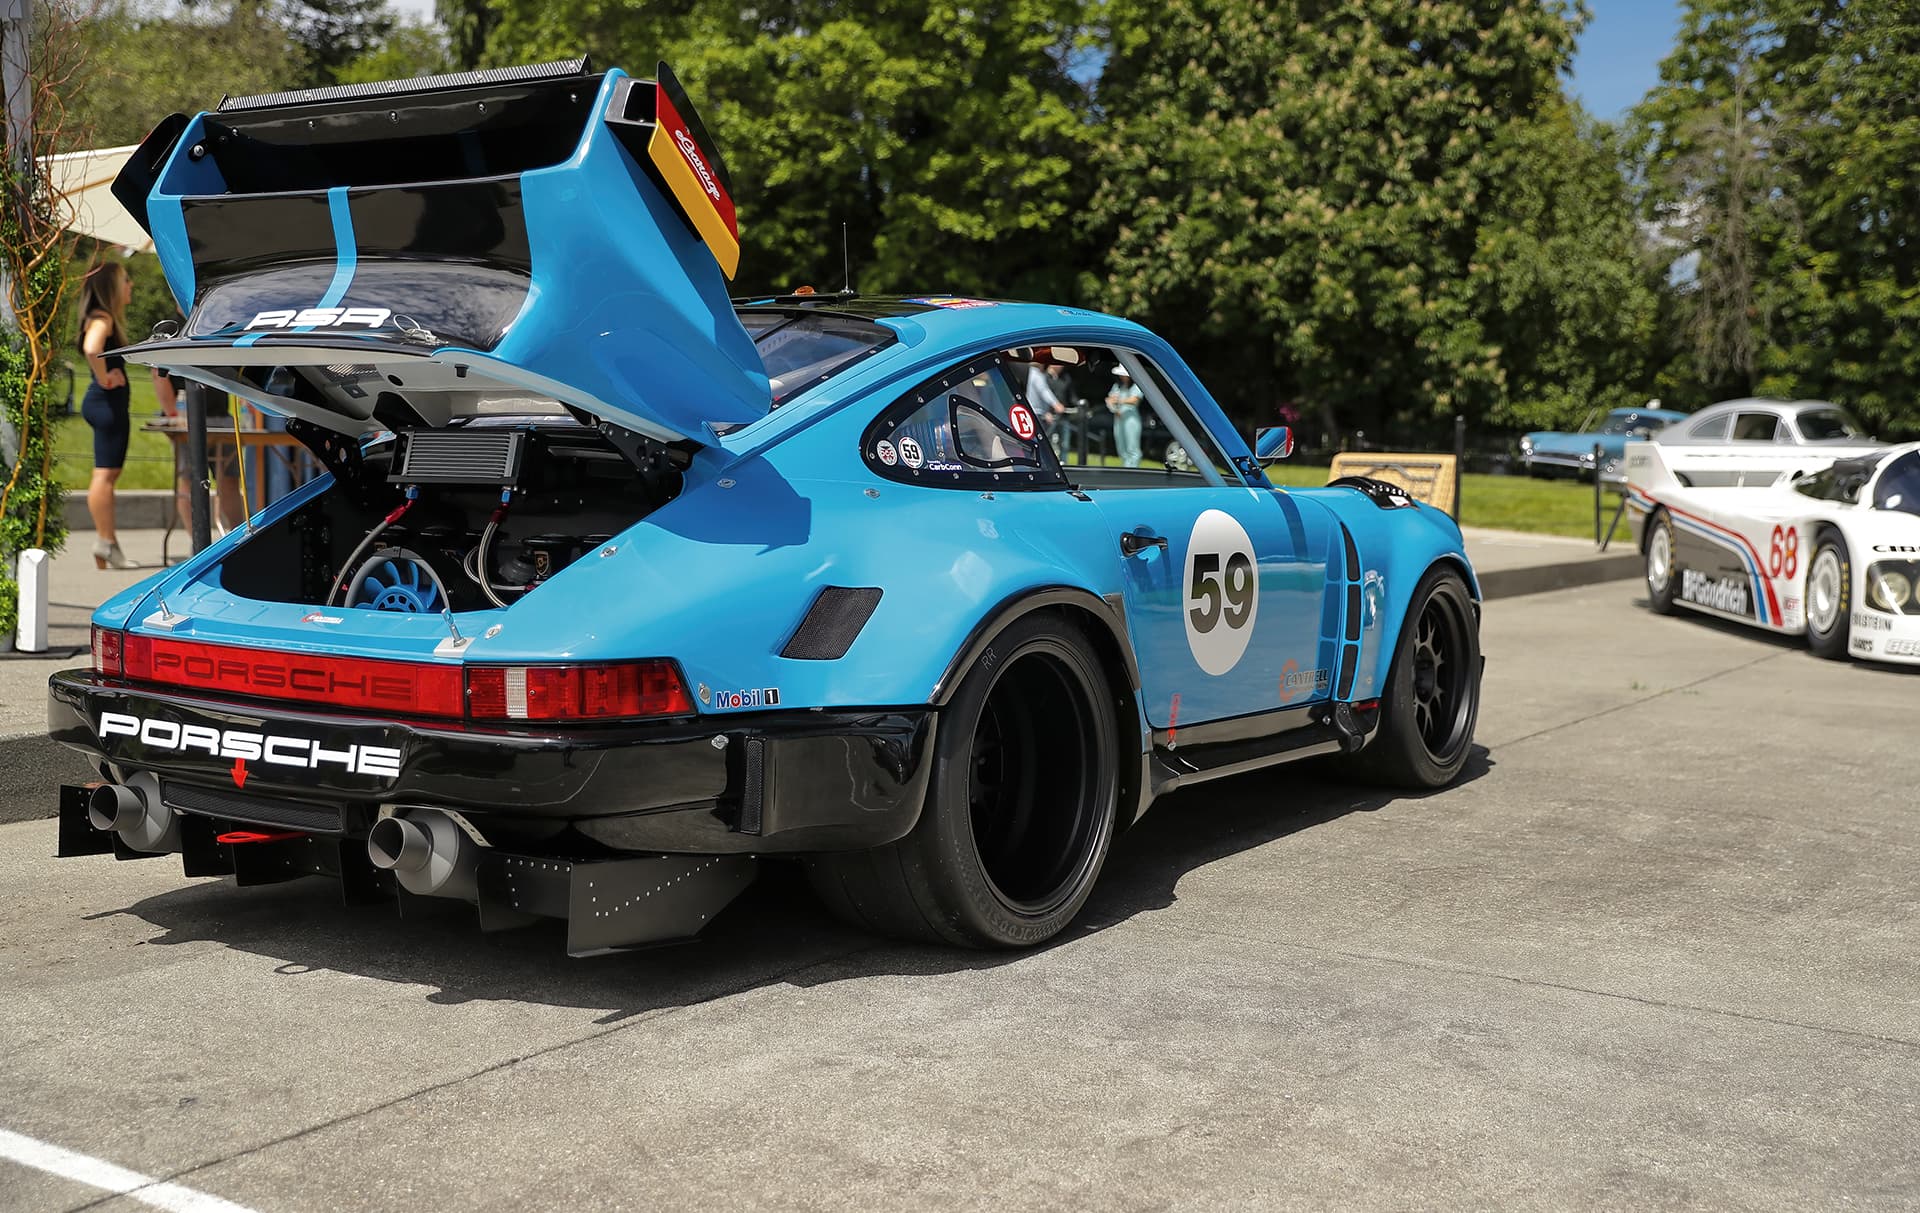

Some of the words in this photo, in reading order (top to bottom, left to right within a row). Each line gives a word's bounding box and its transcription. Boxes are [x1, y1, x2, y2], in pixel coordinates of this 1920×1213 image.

[243, 308, 392, 331] RSR
[1013, 410, 1032, 435] E
[902, 443, 920, 460] 59
[929, 463, 962, 471] CarbConn
[1770, 524, 1799, 580] 68
[1189, 551, 1254, 634] 59
[981, 647, 997, 670] RR
[153, 652, 412, 700] PORSCHE
[716, 688, 761, 709] Mobil
[99, 711, 401, 778] PORSCHE
